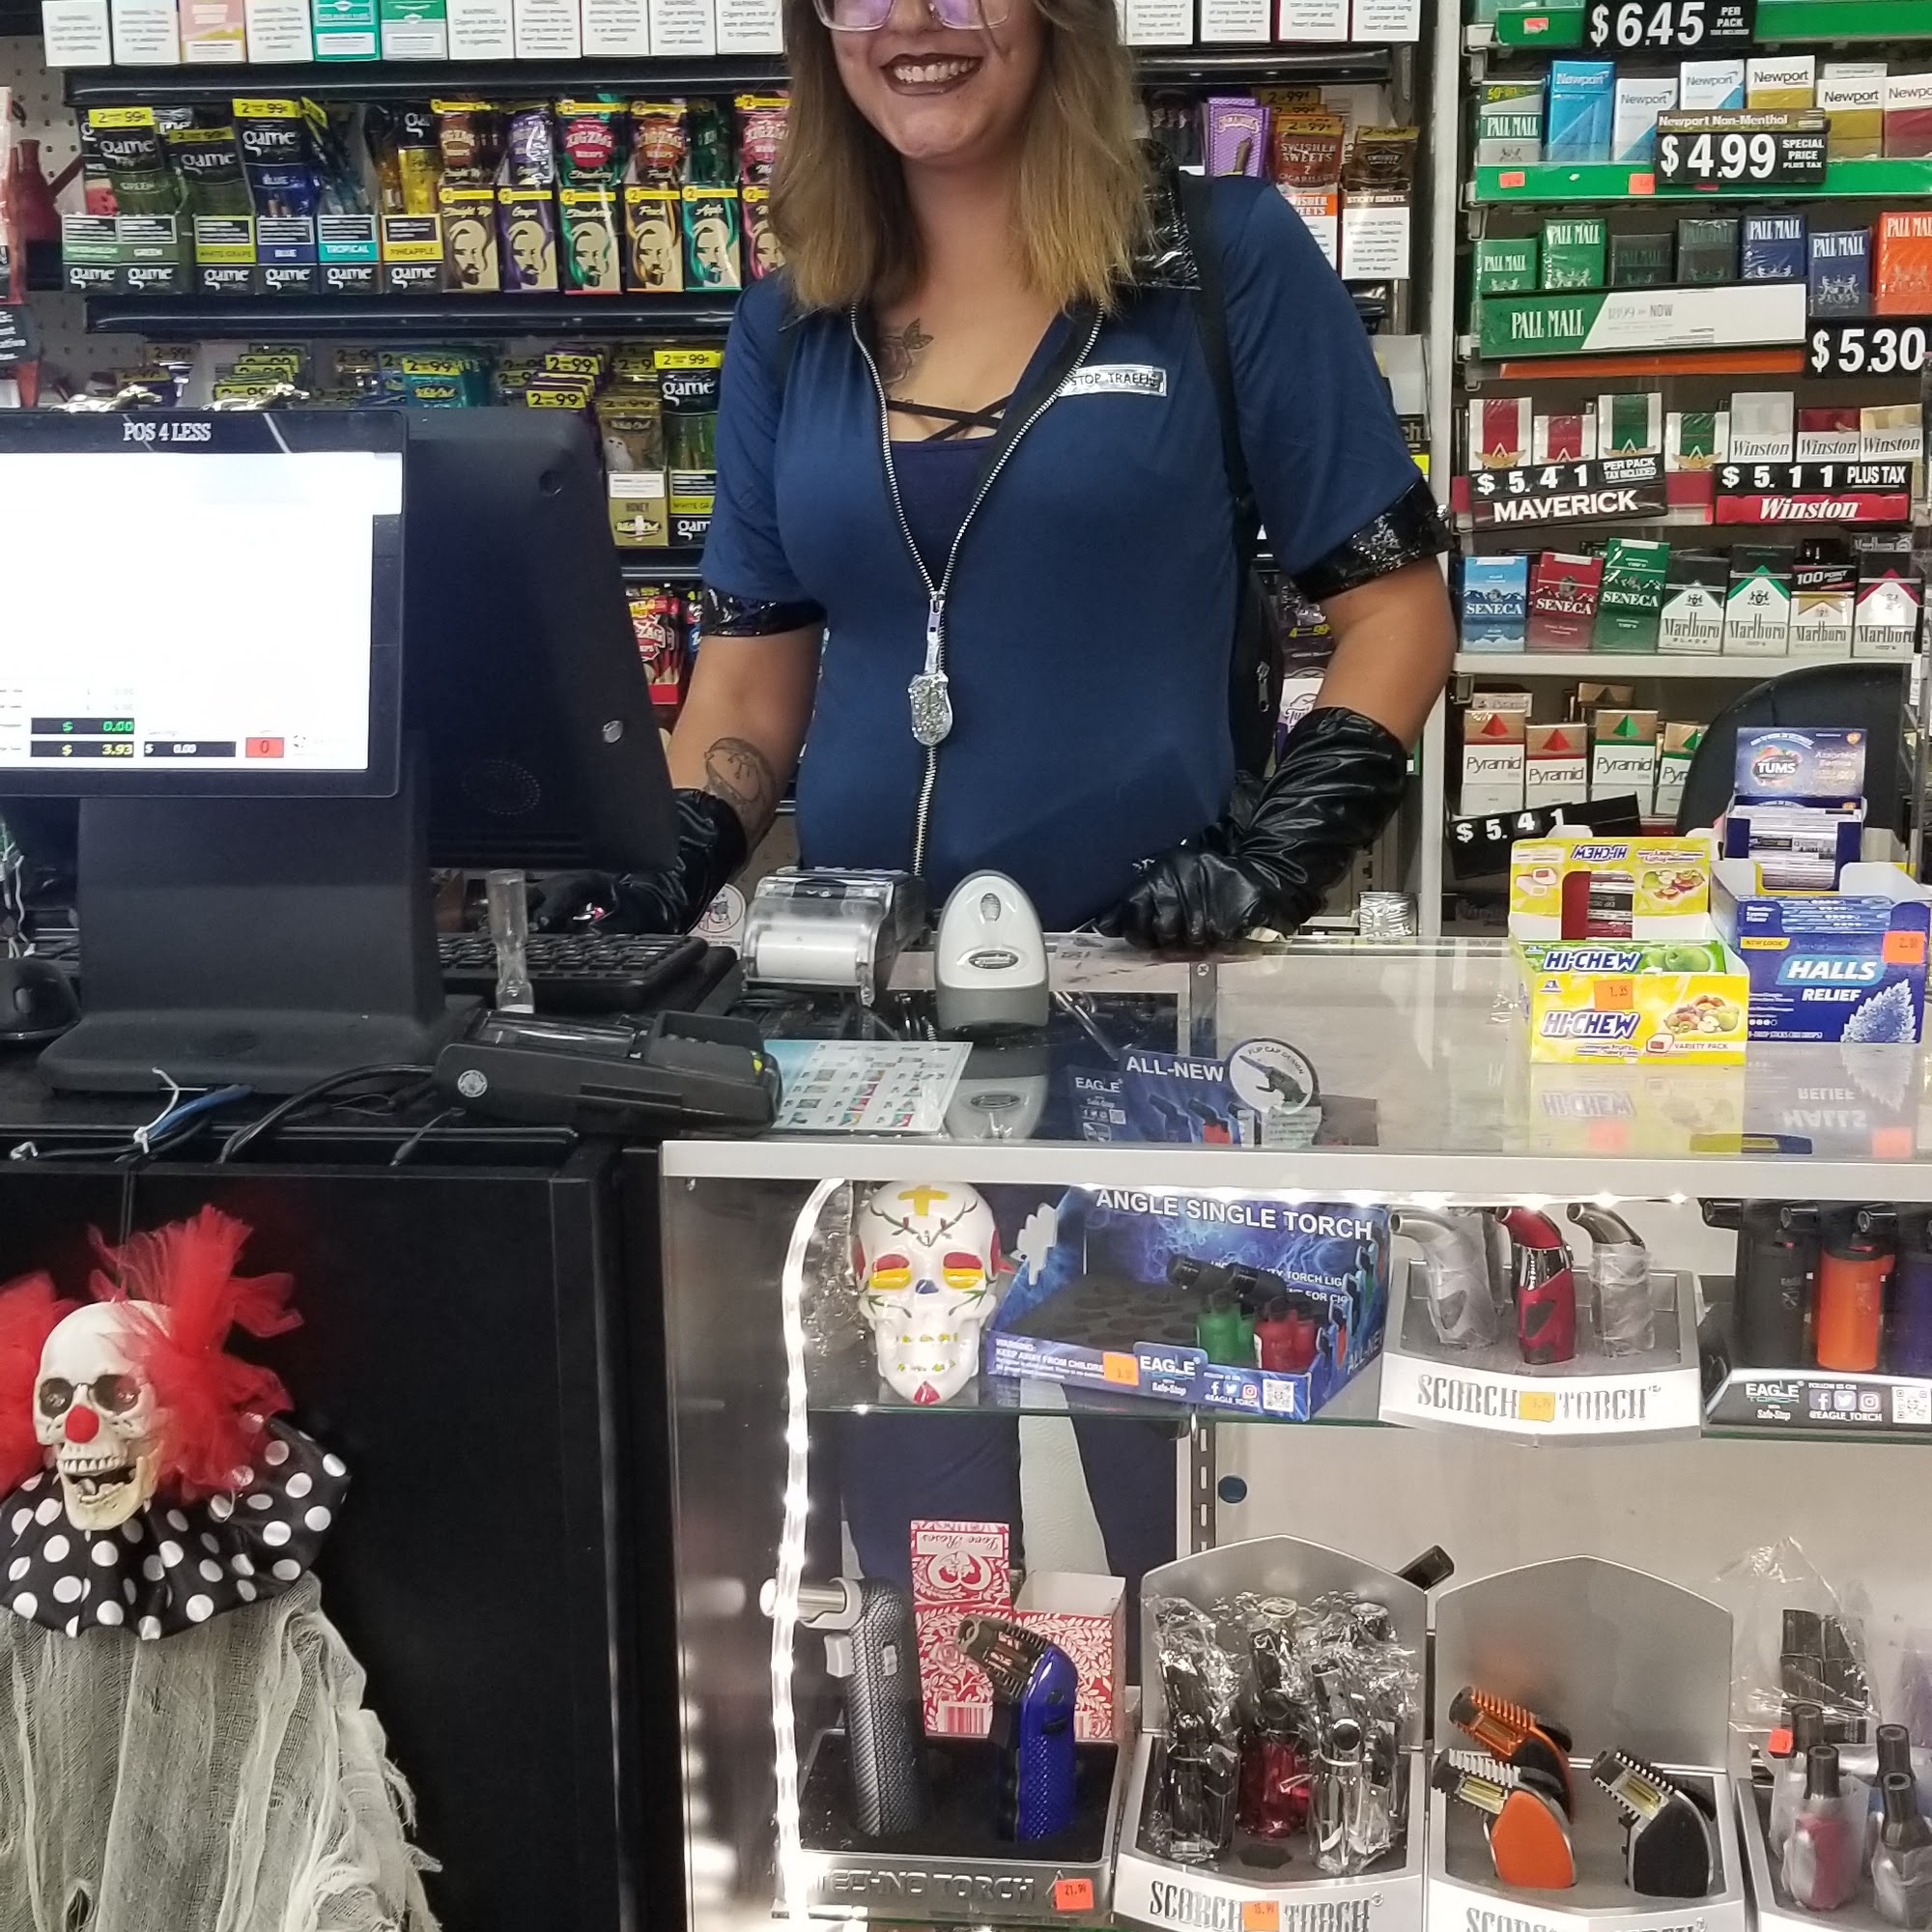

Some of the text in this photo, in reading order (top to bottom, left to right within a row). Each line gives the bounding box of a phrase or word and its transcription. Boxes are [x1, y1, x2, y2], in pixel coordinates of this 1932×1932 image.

[1720, 6, 1742, 16] PER
[1717, 17, 1744, 28] PACK
[1686, 74, 1736, 87] Newport
[1753, 70, 1810, 85] Newport
[1620, 94, 1668, 106] Newport
[1824, 90, 1880, 104] Newport
[1487, 115, 1538, 137] PALL MALL
[1659, 113, 1788, 128] Newport Non-Menthol
[242, 130, 298, 157] game
[1782, 138, 1825, 149] SPECIAL
[181, 152, 236, 175] game
[1282, 152, 1333, 163] SWEETS
[1787, 151, 1818, 160] PRICE
[1548, 223, 1601, 244] PALL MALL
[1749, 218, 1802, 240] PALL MALL
[1887, 217, 1932, 238] PALL MAL
[1813, 235, 1866, 258] PALL MALL
[1484, 254, 1526, 272] PALL MALL
[70, 267, 116, 290] game
[128, 268, 174, 291] game
[203, 269, 249, 291] game
[265, 268, 312, 291] game
[327, 267, 373, 290] game
[390, 267, 438, 290] game
[1649, 304, 1674, 318] NOW
[1511, 308, 1585, 339] PALL MALL
[409, 359, 418, 371] 2
[550, 357, 560, 369] 2
[664, 355, 671, 365] 2
[531, 392, 542, 406] 2
[662, 380, 717, 407] game
[123, 422, 212, 441] POS 4 LESS
[1733, 440, 1790, 456] Winston
[1801, 439, 1858, 456] Winston
[1863, 437, 1920, 454] Winston
[1603, 457, 1656, 471] PER PACK
[1846, 467, 1880, 484] PLUS
[1883, 466, 1907, 484] TAX
[1493, 489, 1639, 524] MAVERICK
[1759, 497, 1861, 520] Winston
[677, 519, 712, 541] gam
[1796, 570, 1824, 585] 100
[1536, 597, 1592, 615] SENECA
[1602, 590, 1659, 608] SENECA
[1465, 603, 1522, 615] SENECA
[1664, 611, 1720, 639] Marlboro
[1729, 612, 1786, 640] Marlboro
[1796, 620, 1847, 641] Marlboro
[1858, 621, 1916, 643] Marlboro
[101, 743, 133, 755] 3.93
[1466, 756, 1522, 774] Pyramid
[1597, 757, 1653, 774] Pyramid
[1757, 762, 1796, 774] TUMS
[1528, 766, 1584, 784] Pyramid
[1543, 950, 1642, 973] HI-CHEW
[1787, 960, 1877, 980] HALLS
[1802, 988, 1862, 1002] RELIEF
[1541, 1011, 1641, 1039] HI-CHEW
[1126, 1056, 1225, 1082] ALL-NEW
[1075, 1076, 1122, 1094] EAGLE
[1095, 1188, 1373, 1241] ANGLE SINGLE TORCH
[1287, 1269, 1323, 1285] TORCH
[1042, 1354, 1067, 1367] FROM
[1139, 1355, 1197, 1377] EAGLE
[1417, 1374, 1647, 1421] SCORCH TORCH
[1746, 1381, 1801, 1398] EAGLE
[922, 1531, 1001, 1553] Love Roses
[932, 1872, 1035, 1900] TORCH
[1150, 1879, 1243, 1932] SCORCH
